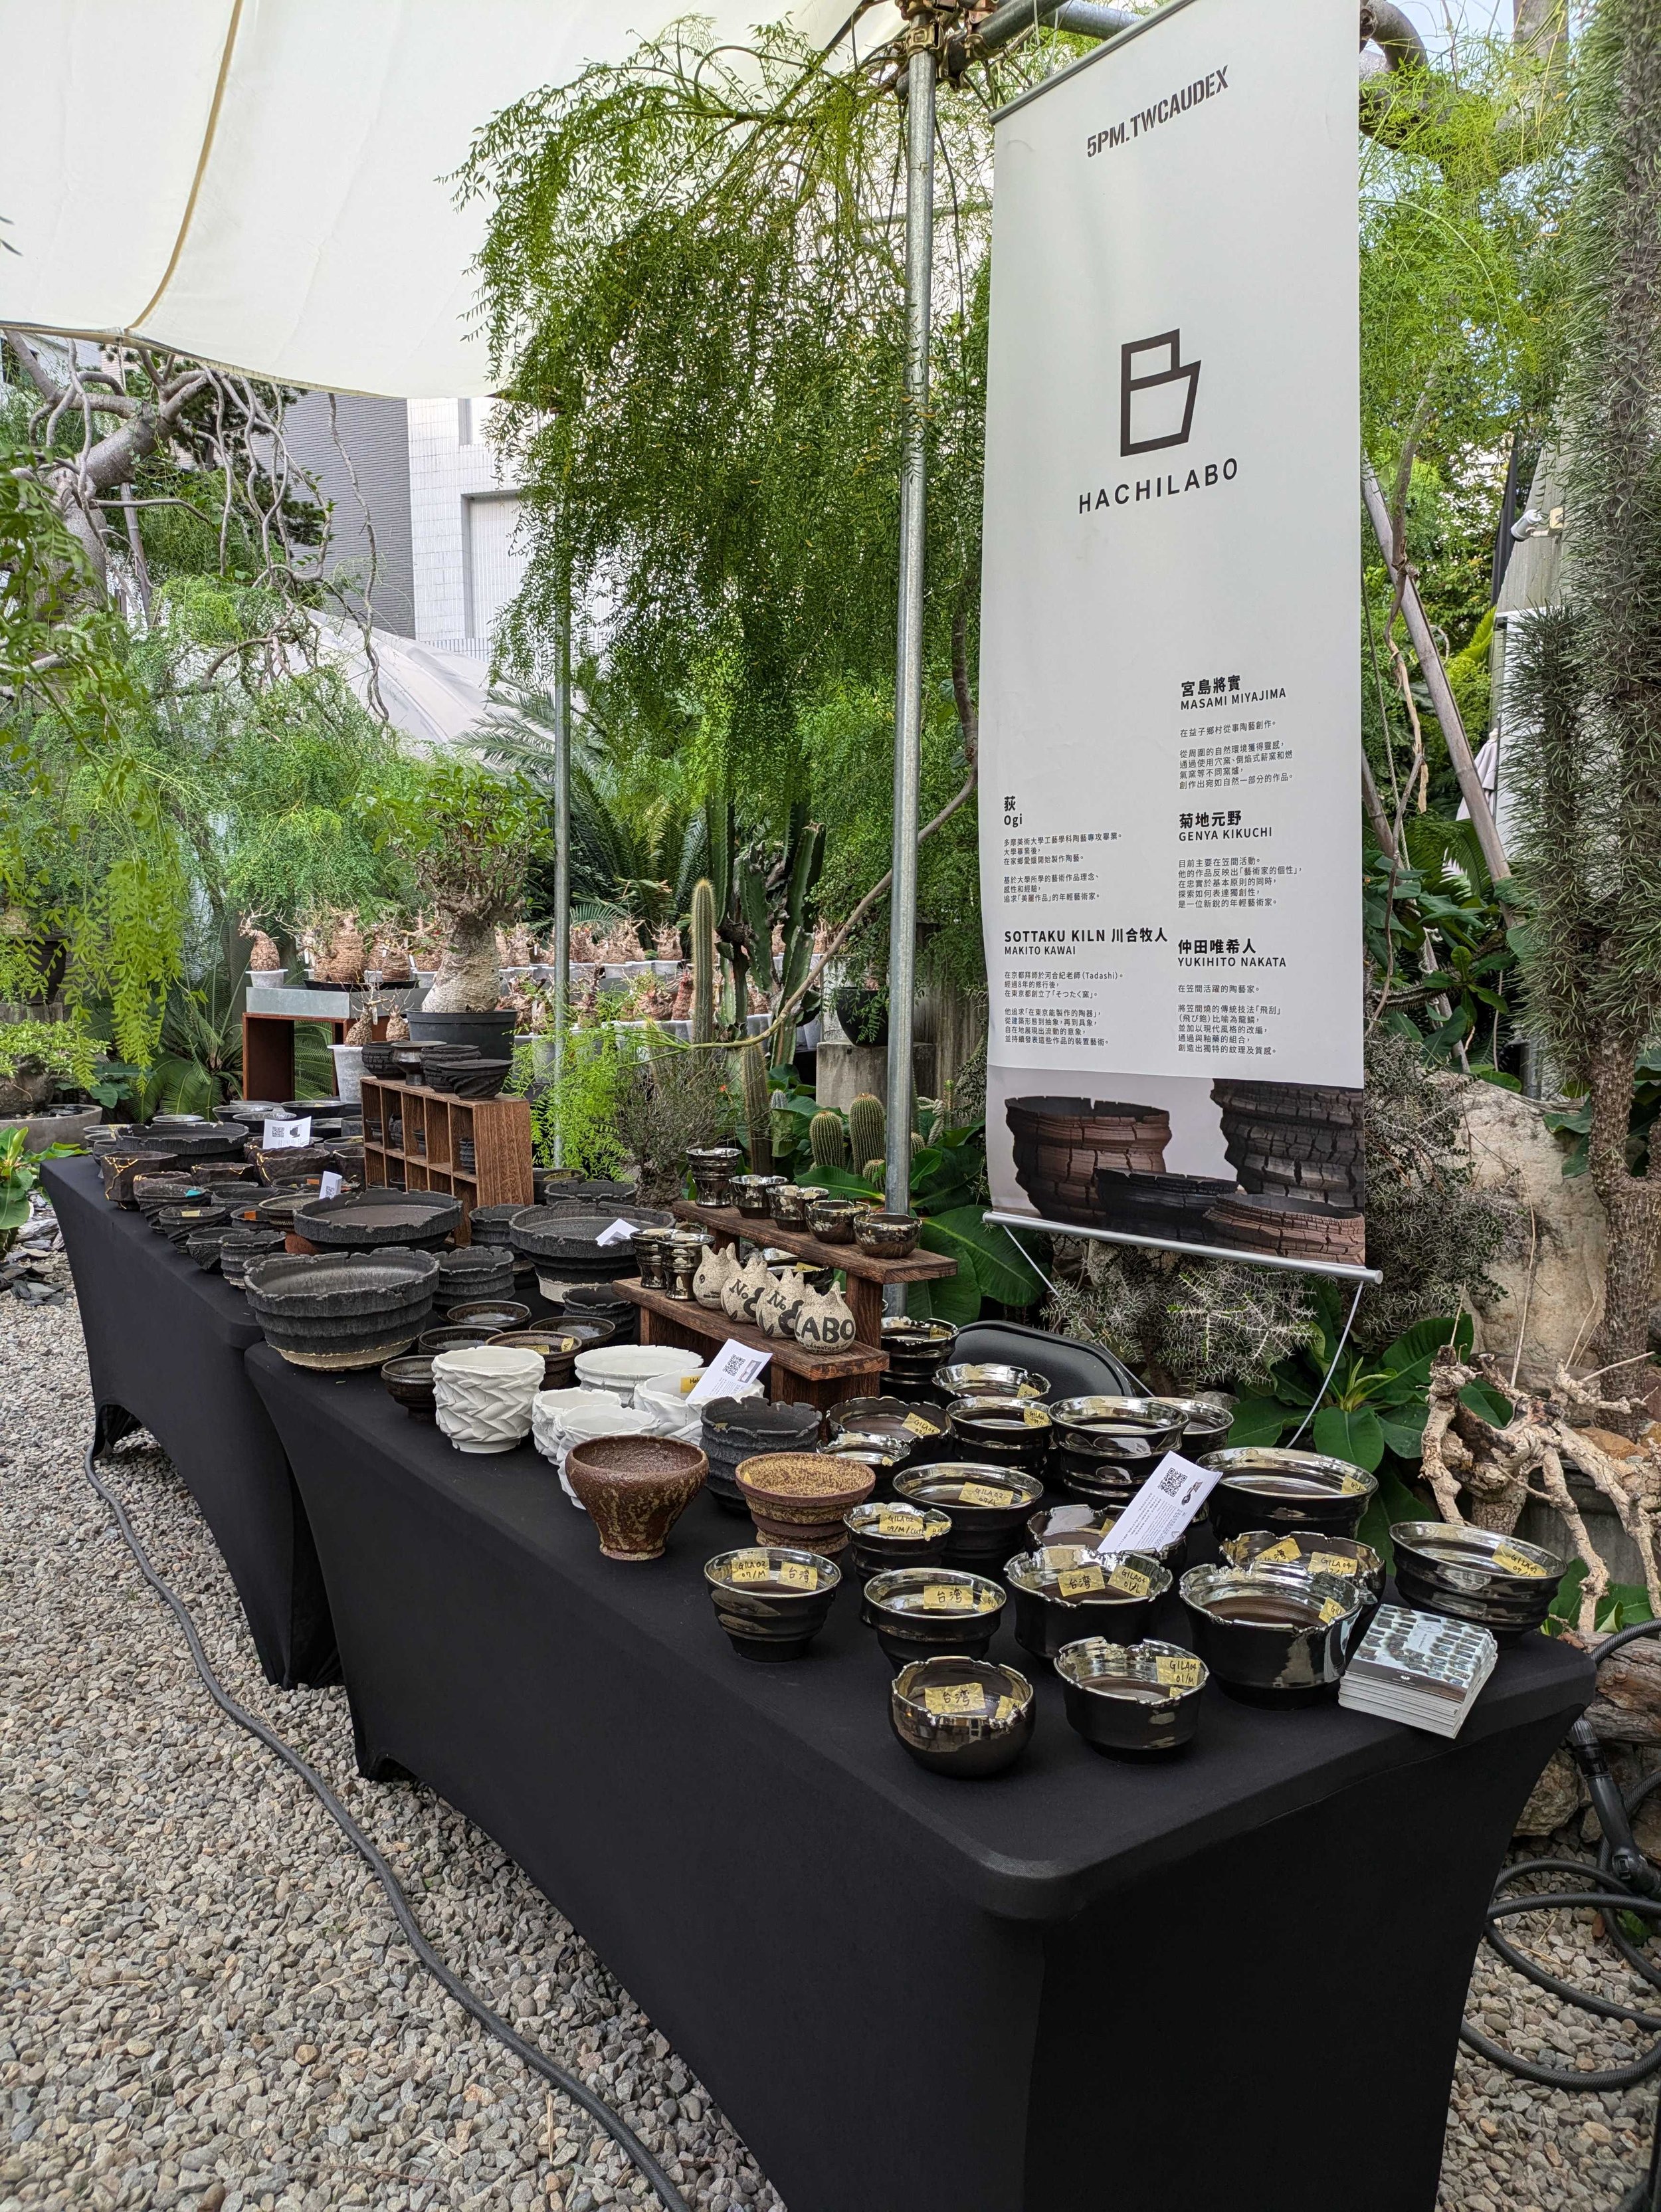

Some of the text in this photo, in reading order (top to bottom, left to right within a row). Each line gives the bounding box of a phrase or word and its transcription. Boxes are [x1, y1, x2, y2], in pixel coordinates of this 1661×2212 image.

[1087, 65, 1229, 157] 5PM.TWCAUDEX
[1079, 458, 1238, 514] HACHILABO
[1181, 674, 1240, 698] 宮島將實
[1181, 688, 1286, 710] MASAMI MIYAJIMA
[1003, 795, 1017, 812] 荻
[1003, 813, 1023, 828] Ogi
[1179, 810, 1242, 829] 菊地元野
[1179, 827, 1272, 841] GENYA KIKUCHI
[1005, 927, 1168, 943] SOTTAKU KILN 川合牧人
[1005, 946, 1076, 955] MAKITO KAWAI
[1178, 938, 1256, 955] 仲田唯希人
[1178, 957, 1286, 967] YUKIHITO NAKATA
[1070, 1574, 1092, 1589] 台湾
[937, 1587, 962, 1603] 台湾
[943, 1689, 970, 1706] 台湾
